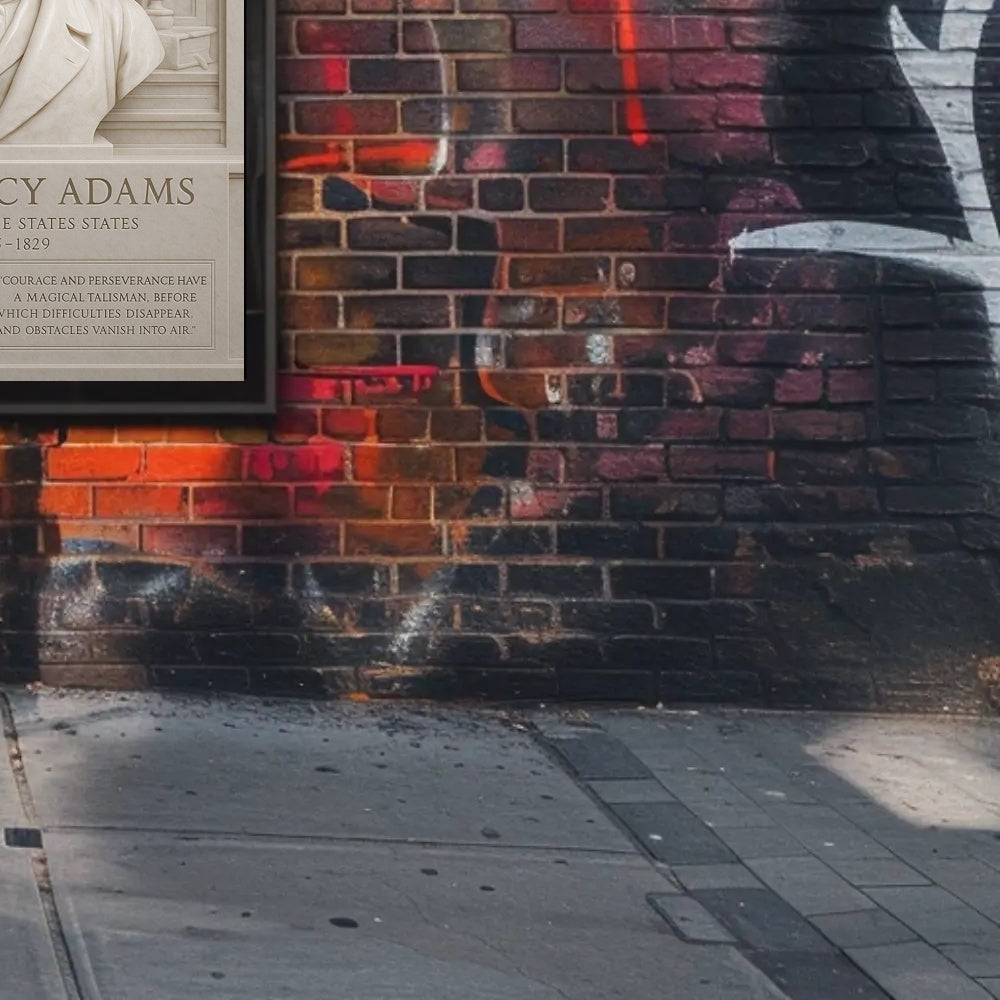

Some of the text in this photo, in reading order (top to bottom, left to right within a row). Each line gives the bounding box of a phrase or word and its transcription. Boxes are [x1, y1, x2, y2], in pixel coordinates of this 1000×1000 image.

[58, 177, 195, 206] ADAMS
[18, 217, 76, 230] STATES
[81, 217, 140, 230] STATES
[60, 275, 86, 286] AND
[88, 275, 175, 286] PERSEVERANCE
[177, 275, 208, 286] HAVE
[13, 292, 197, 304] A MAGICAL TALISMAN, BEFORE
[42, 308, 121, 319] DIFFICULTIES
[25, 325, 89, 336] OBSTACLES
[92, 325, 135, 336] VANISH
[139, 325, 167, 336] INTO
